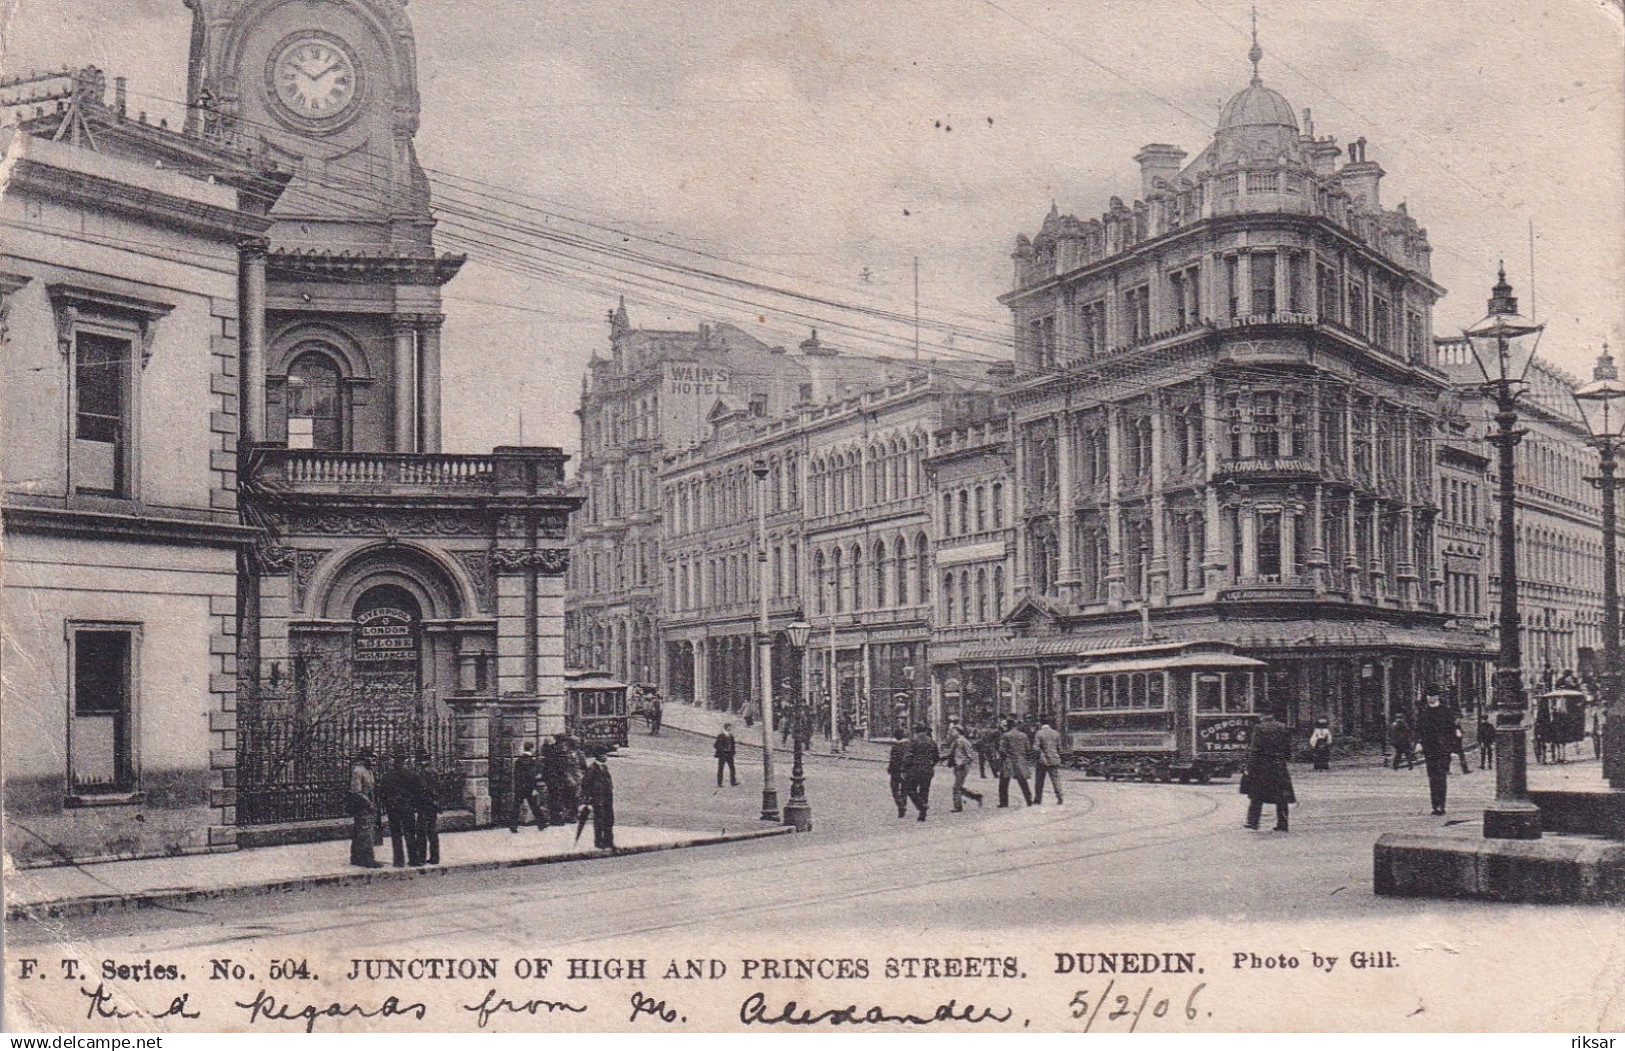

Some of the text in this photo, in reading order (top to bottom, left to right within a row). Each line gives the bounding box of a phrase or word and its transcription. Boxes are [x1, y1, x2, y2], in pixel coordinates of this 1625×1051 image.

[671, 367, 728, 381] WAIN'S
[671, 382, 726, 395] HOTEL
[358, 608, 410, 623] LIVERPOOL
[464, 989, 587, 1027] from
